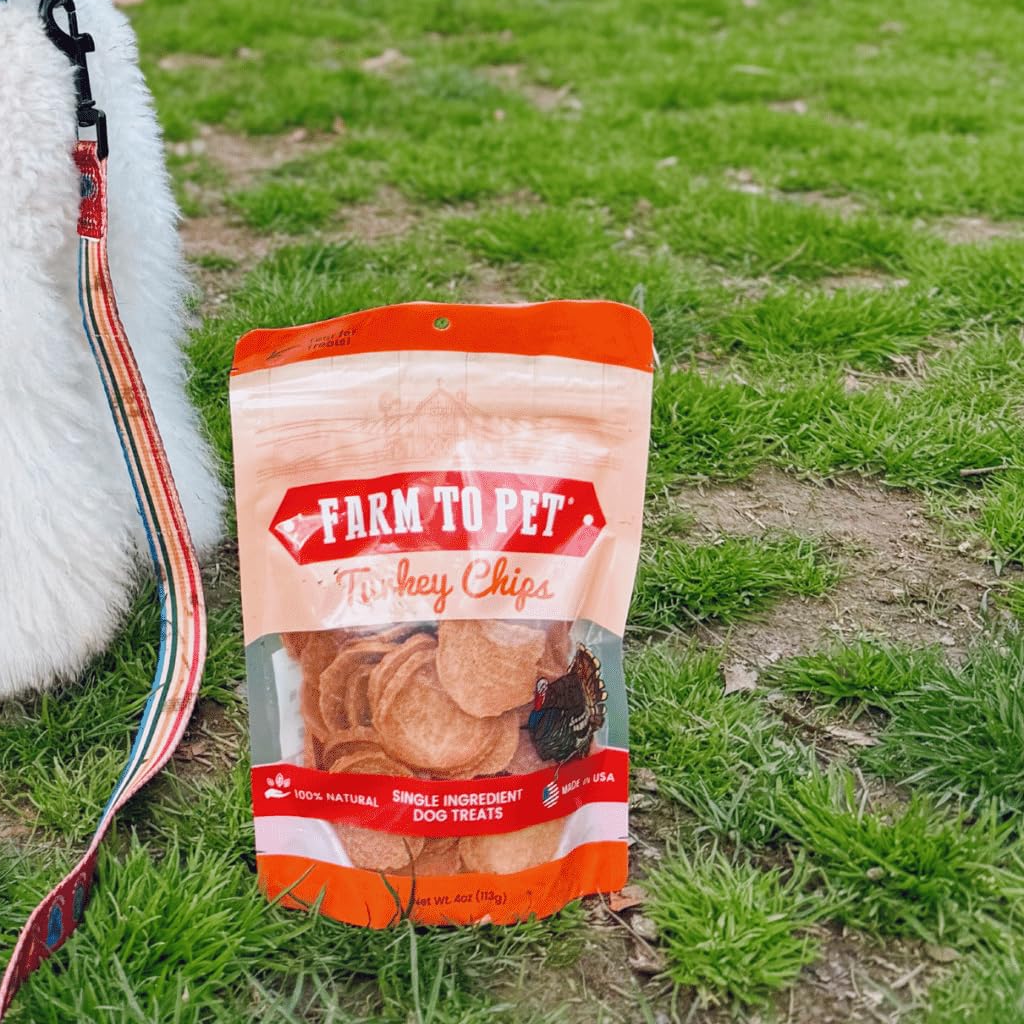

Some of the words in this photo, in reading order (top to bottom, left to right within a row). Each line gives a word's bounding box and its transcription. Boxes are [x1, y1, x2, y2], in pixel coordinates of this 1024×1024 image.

[318, 487, 423, 544] FARM
[433, 486, 483, 532] TO
[495, 487, 565, 537] PET
[462, 556, 554, 612] Chips
[561, 778, 581, 795] MADE
[593, 772, 615, 782] USA
[294, 789, 323, 801] 100%
[327, 792, 379, 808] NATURAL
[392, 789, 439, 807] SINGLE
[443, 788, 523, 807] INGREDIENT
[413, 809, 447, 822] DOG
[451, 807, 503, 822] TREATS
[476, 889, 507, 906] (113g)
